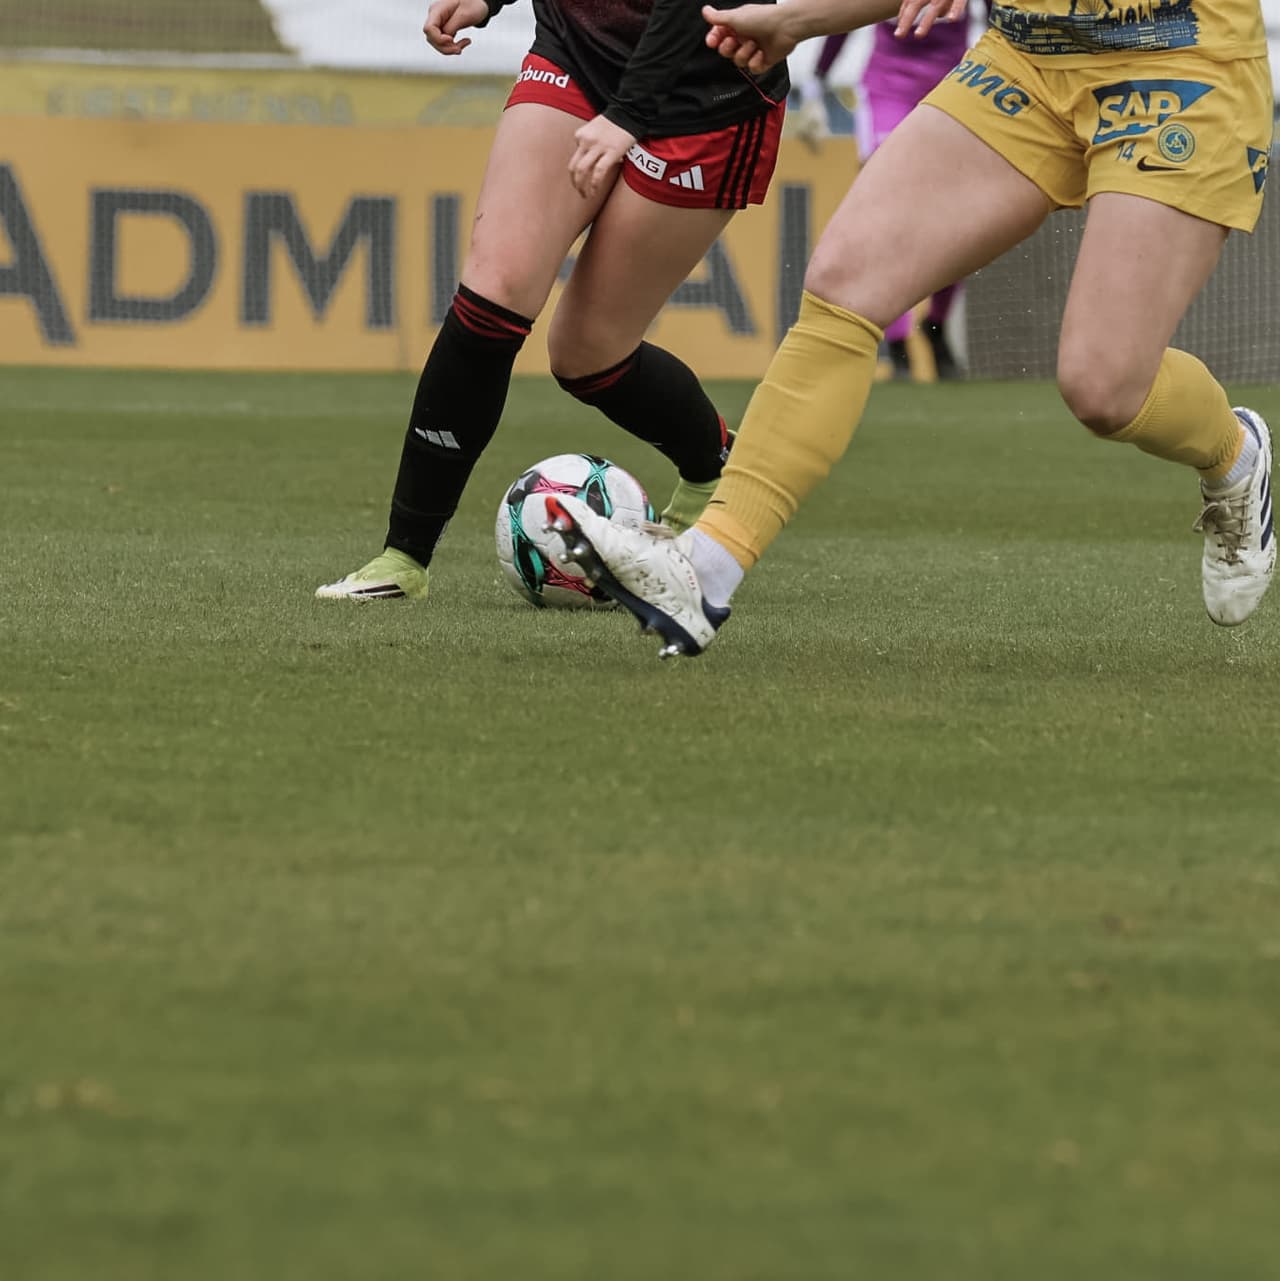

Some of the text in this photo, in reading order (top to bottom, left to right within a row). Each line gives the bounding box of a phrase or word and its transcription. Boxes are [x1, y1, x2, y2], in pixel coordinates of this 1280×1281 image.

[954, 60, 1031, 116] PMG
[1099, 90, 1182, 135] SAP
[635, 153, 661, 174] AG
